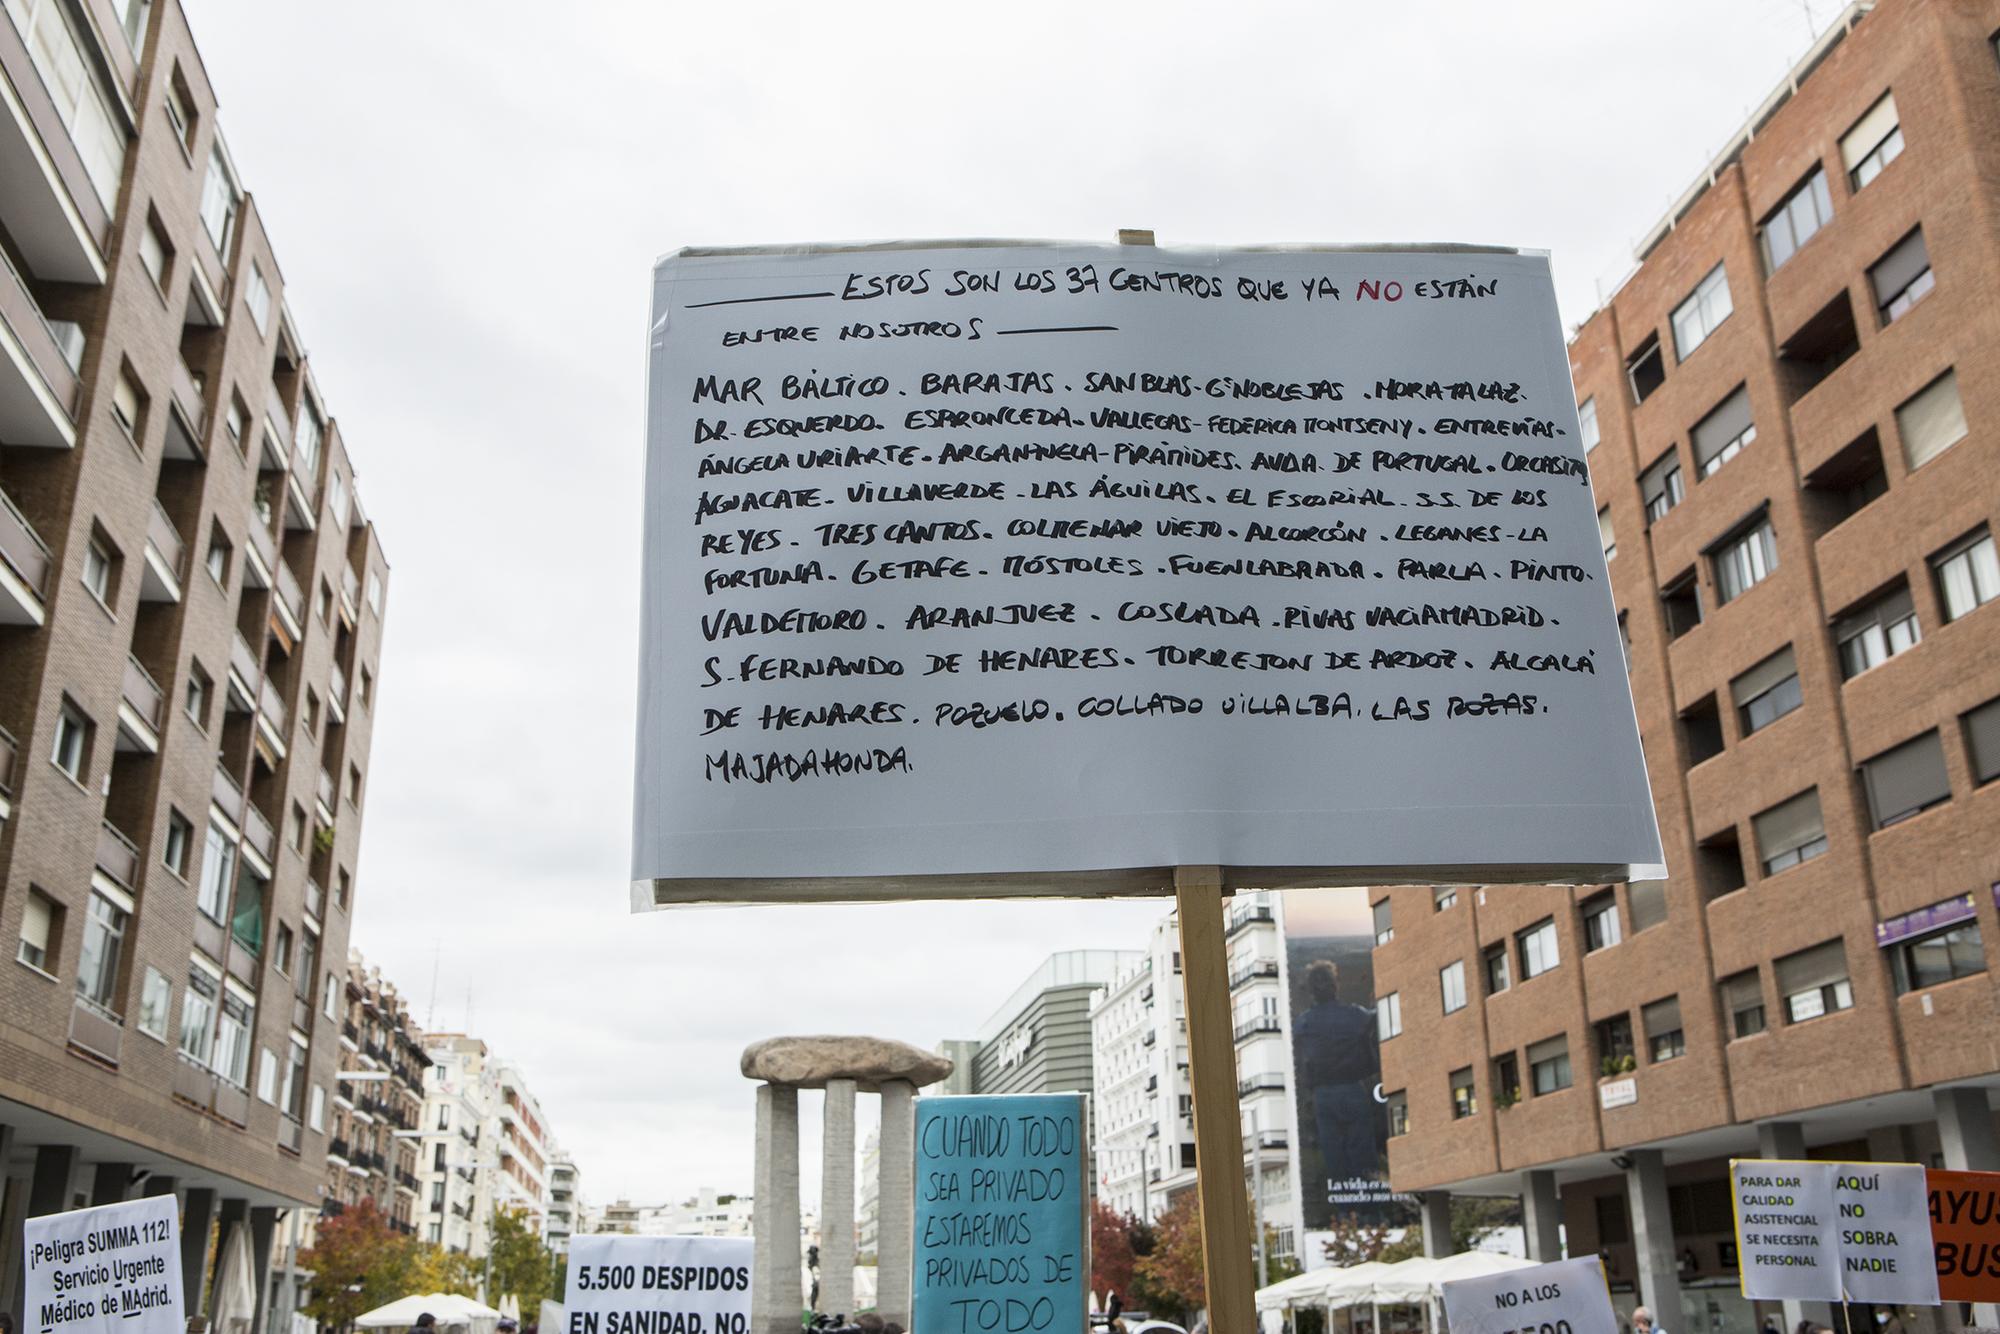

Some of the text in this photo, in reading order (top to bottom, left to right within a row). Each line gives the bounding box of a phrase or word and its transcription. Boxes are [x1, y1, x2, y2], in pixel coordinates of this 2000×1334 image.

[841, 263, 1498, 303] ESTOS SON LOS 37 CENTROS QUE YA NO ESTÁN
[721, 317, 984, 348] ENTRE NOSOTROS
[692, 374, 765, 406] MAR
[697, 452, 790, 479] ÁNGELA
[1331, 451, 1363, 474] DE
[1030, 480, 1079, 500] LAS
[1225, 487, 1257, 507] EL
[1466, 488, 1504, 508] DE
[1510, 488, 1549, 508] LOS
[813, 522, 879, 547] TRES
[1006, 518, 1143, 540] COLMENAR
[922, 653, 963, 677] DE
[1323, 651, 1362, 671] DE
[699, 706, 742, 737] DE
[1077, 691, 1204, 718] COLLADO
[1370, 695, 1431, 722] LAS
[922, 1114, 1074, 1159] CUANDO TODO
[924, 1168, 1065, 1203] SEA PRIVADO
[1741, 1177, 1801, 1188] PARA DAR
[1836, 1175, 1880, 1191] AQUÍ
[1742, 1195, 1794, 1206] CALIDAD
[1840, 1203, 1865, 1218] NO
[923, 1212, 1032, 1249] ESTAREMOS
[1745, 1214, 1818, 1225] ASISTENCIAL
[30, 1218, 170, 1270] ¡Peligra SUMMA 112!
[1746, 1234, 1819, 1246] SE NECESITA
[1843, 1231, 1898, 1246] SOBRA
[53, 1255, 165, 1292] Servicio Urgente
[925, 1254, 1074, 1288] PRIVADOS DE
[1755, 1255, 1817, 1267] PERSONAL
[1846, 1257, 1896, 1272] NADIE
[578, 1265, 749, 1291] 5.500 DESPIDOS
[41, 1301, 95, 1327] Médico
[101, 1292, 118, 1316] de
[1495, 1283, 1561, 1309] NO A LOS
[569, 1312, 599, 1334] EN
[951, 1296, 1055, 1334] TODO
